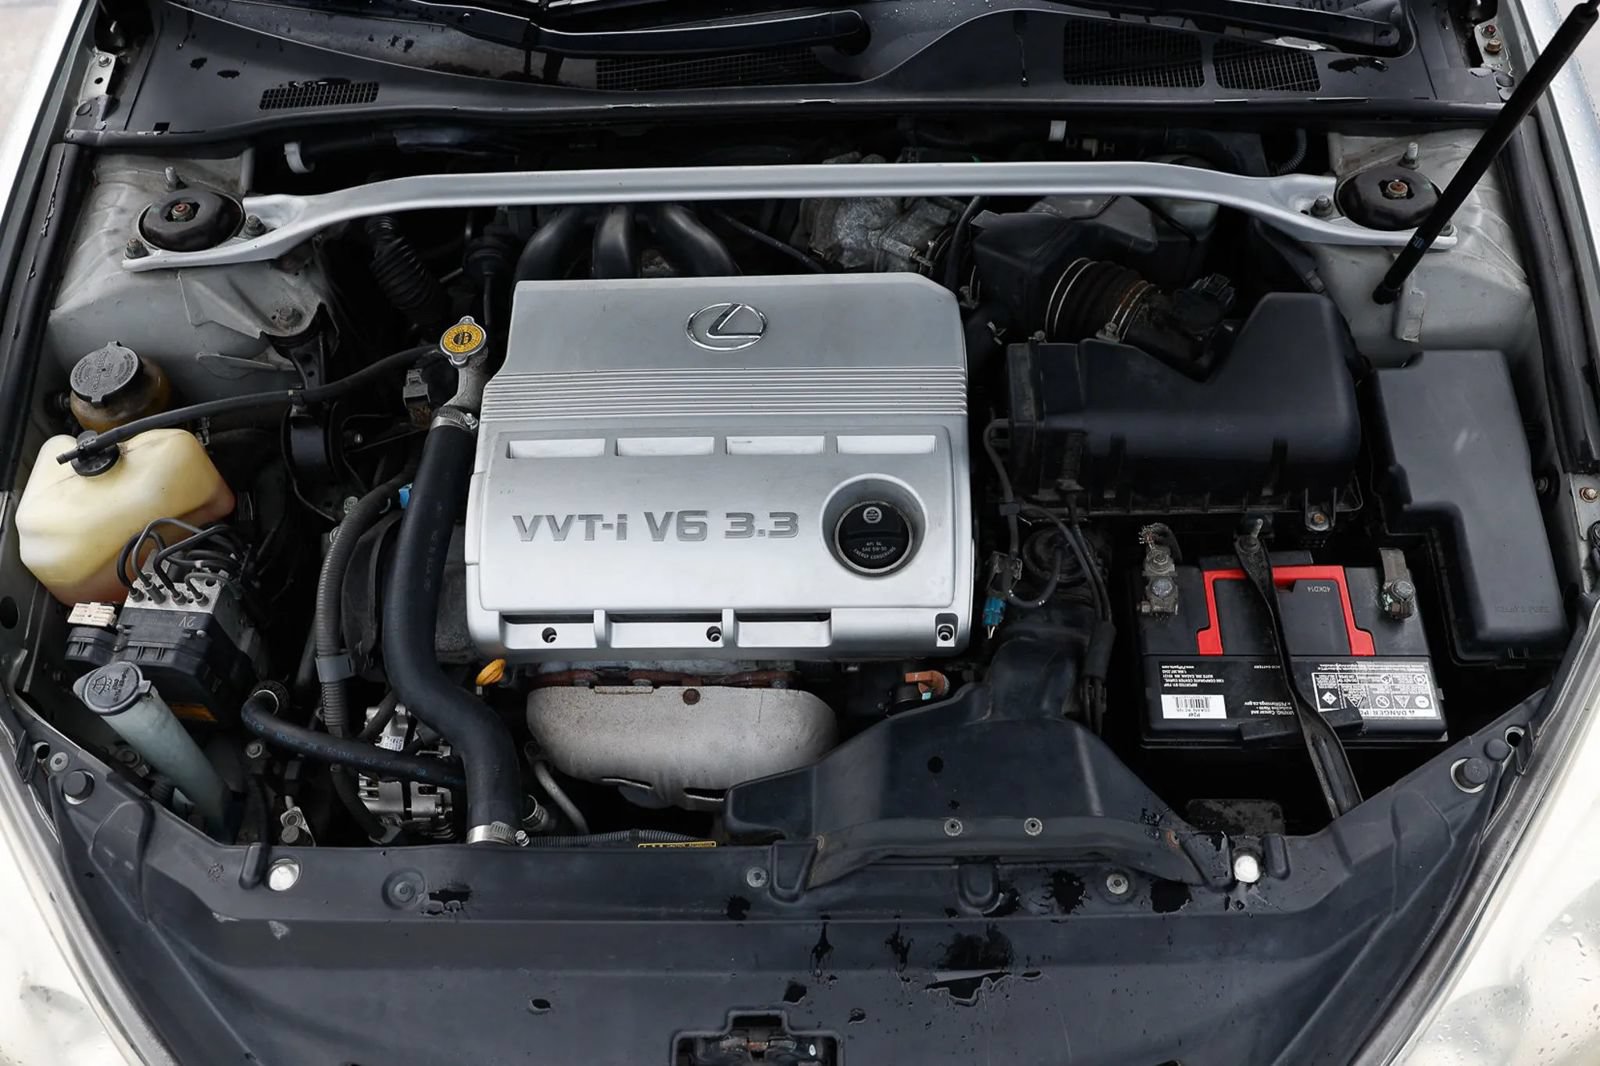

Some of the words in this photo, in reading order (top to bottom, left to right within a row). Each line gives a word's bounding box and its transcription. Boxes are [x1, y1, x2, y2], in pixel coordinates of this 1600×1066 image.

[512, 513, 629, 542] VVT-i
[644, 510, 709, 542] V6
[724, 511, 800, 540] 3.3
